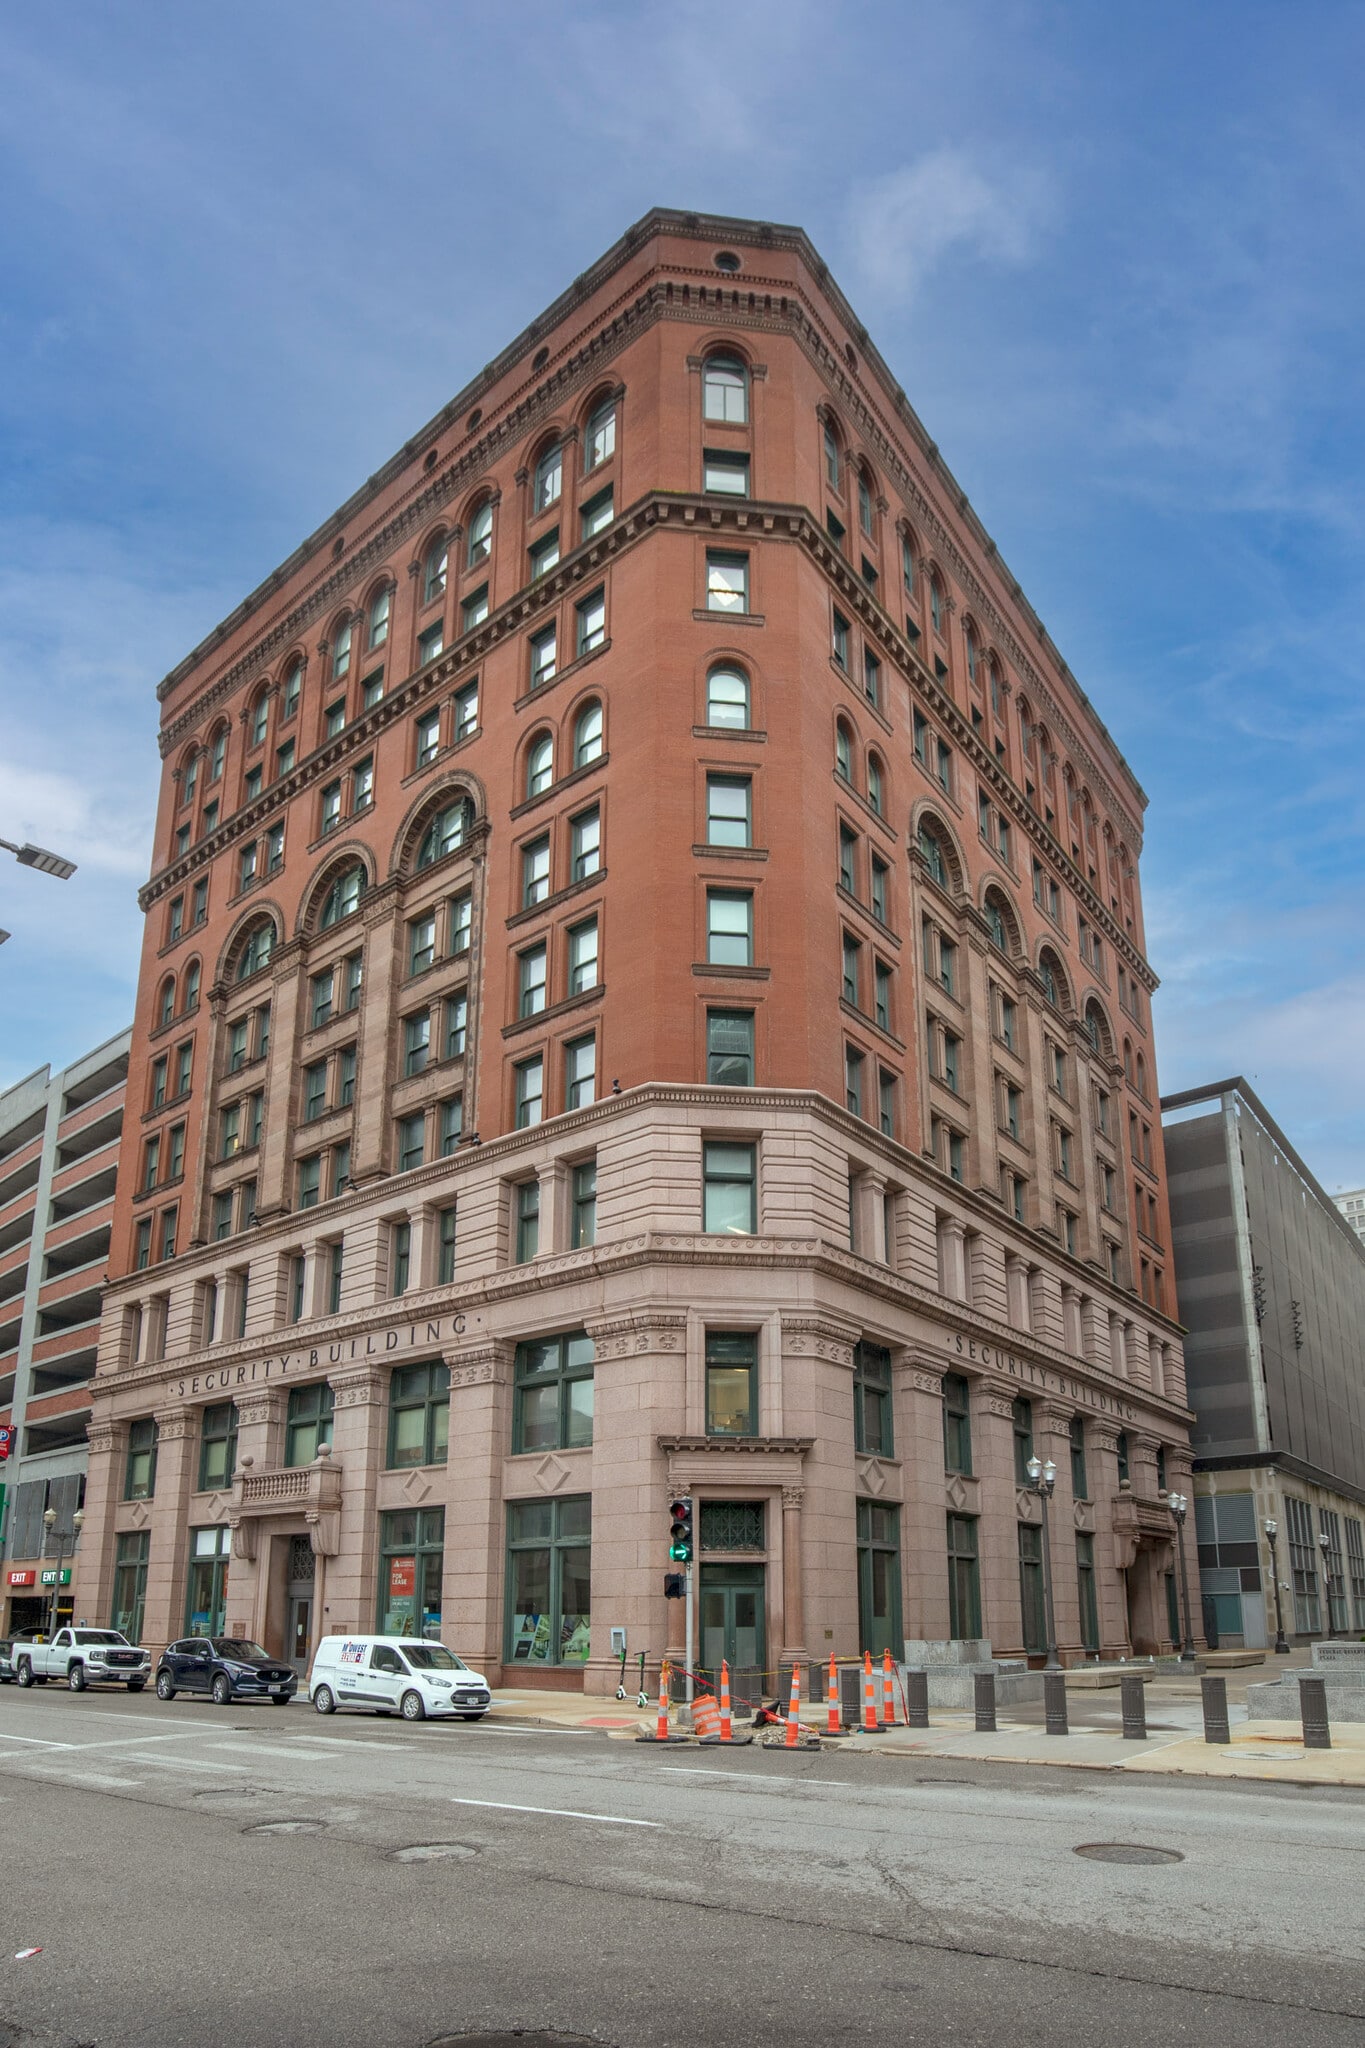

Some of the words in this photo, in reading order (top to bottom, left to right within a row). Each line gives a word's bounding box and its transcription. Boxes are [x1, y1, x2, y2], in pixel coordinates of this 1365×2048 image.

[178, 1355, 290, 1397] SECURITY
[309, 1315, 466, 1368] BUILDING
[955, 1335, 1049, 1387] SECURITY
[1060, 1378, 1133, 1421] BUILDING
[11, 1572, 26, 1583] EXIT
[42, 1571, 64, 1582] ENTR
